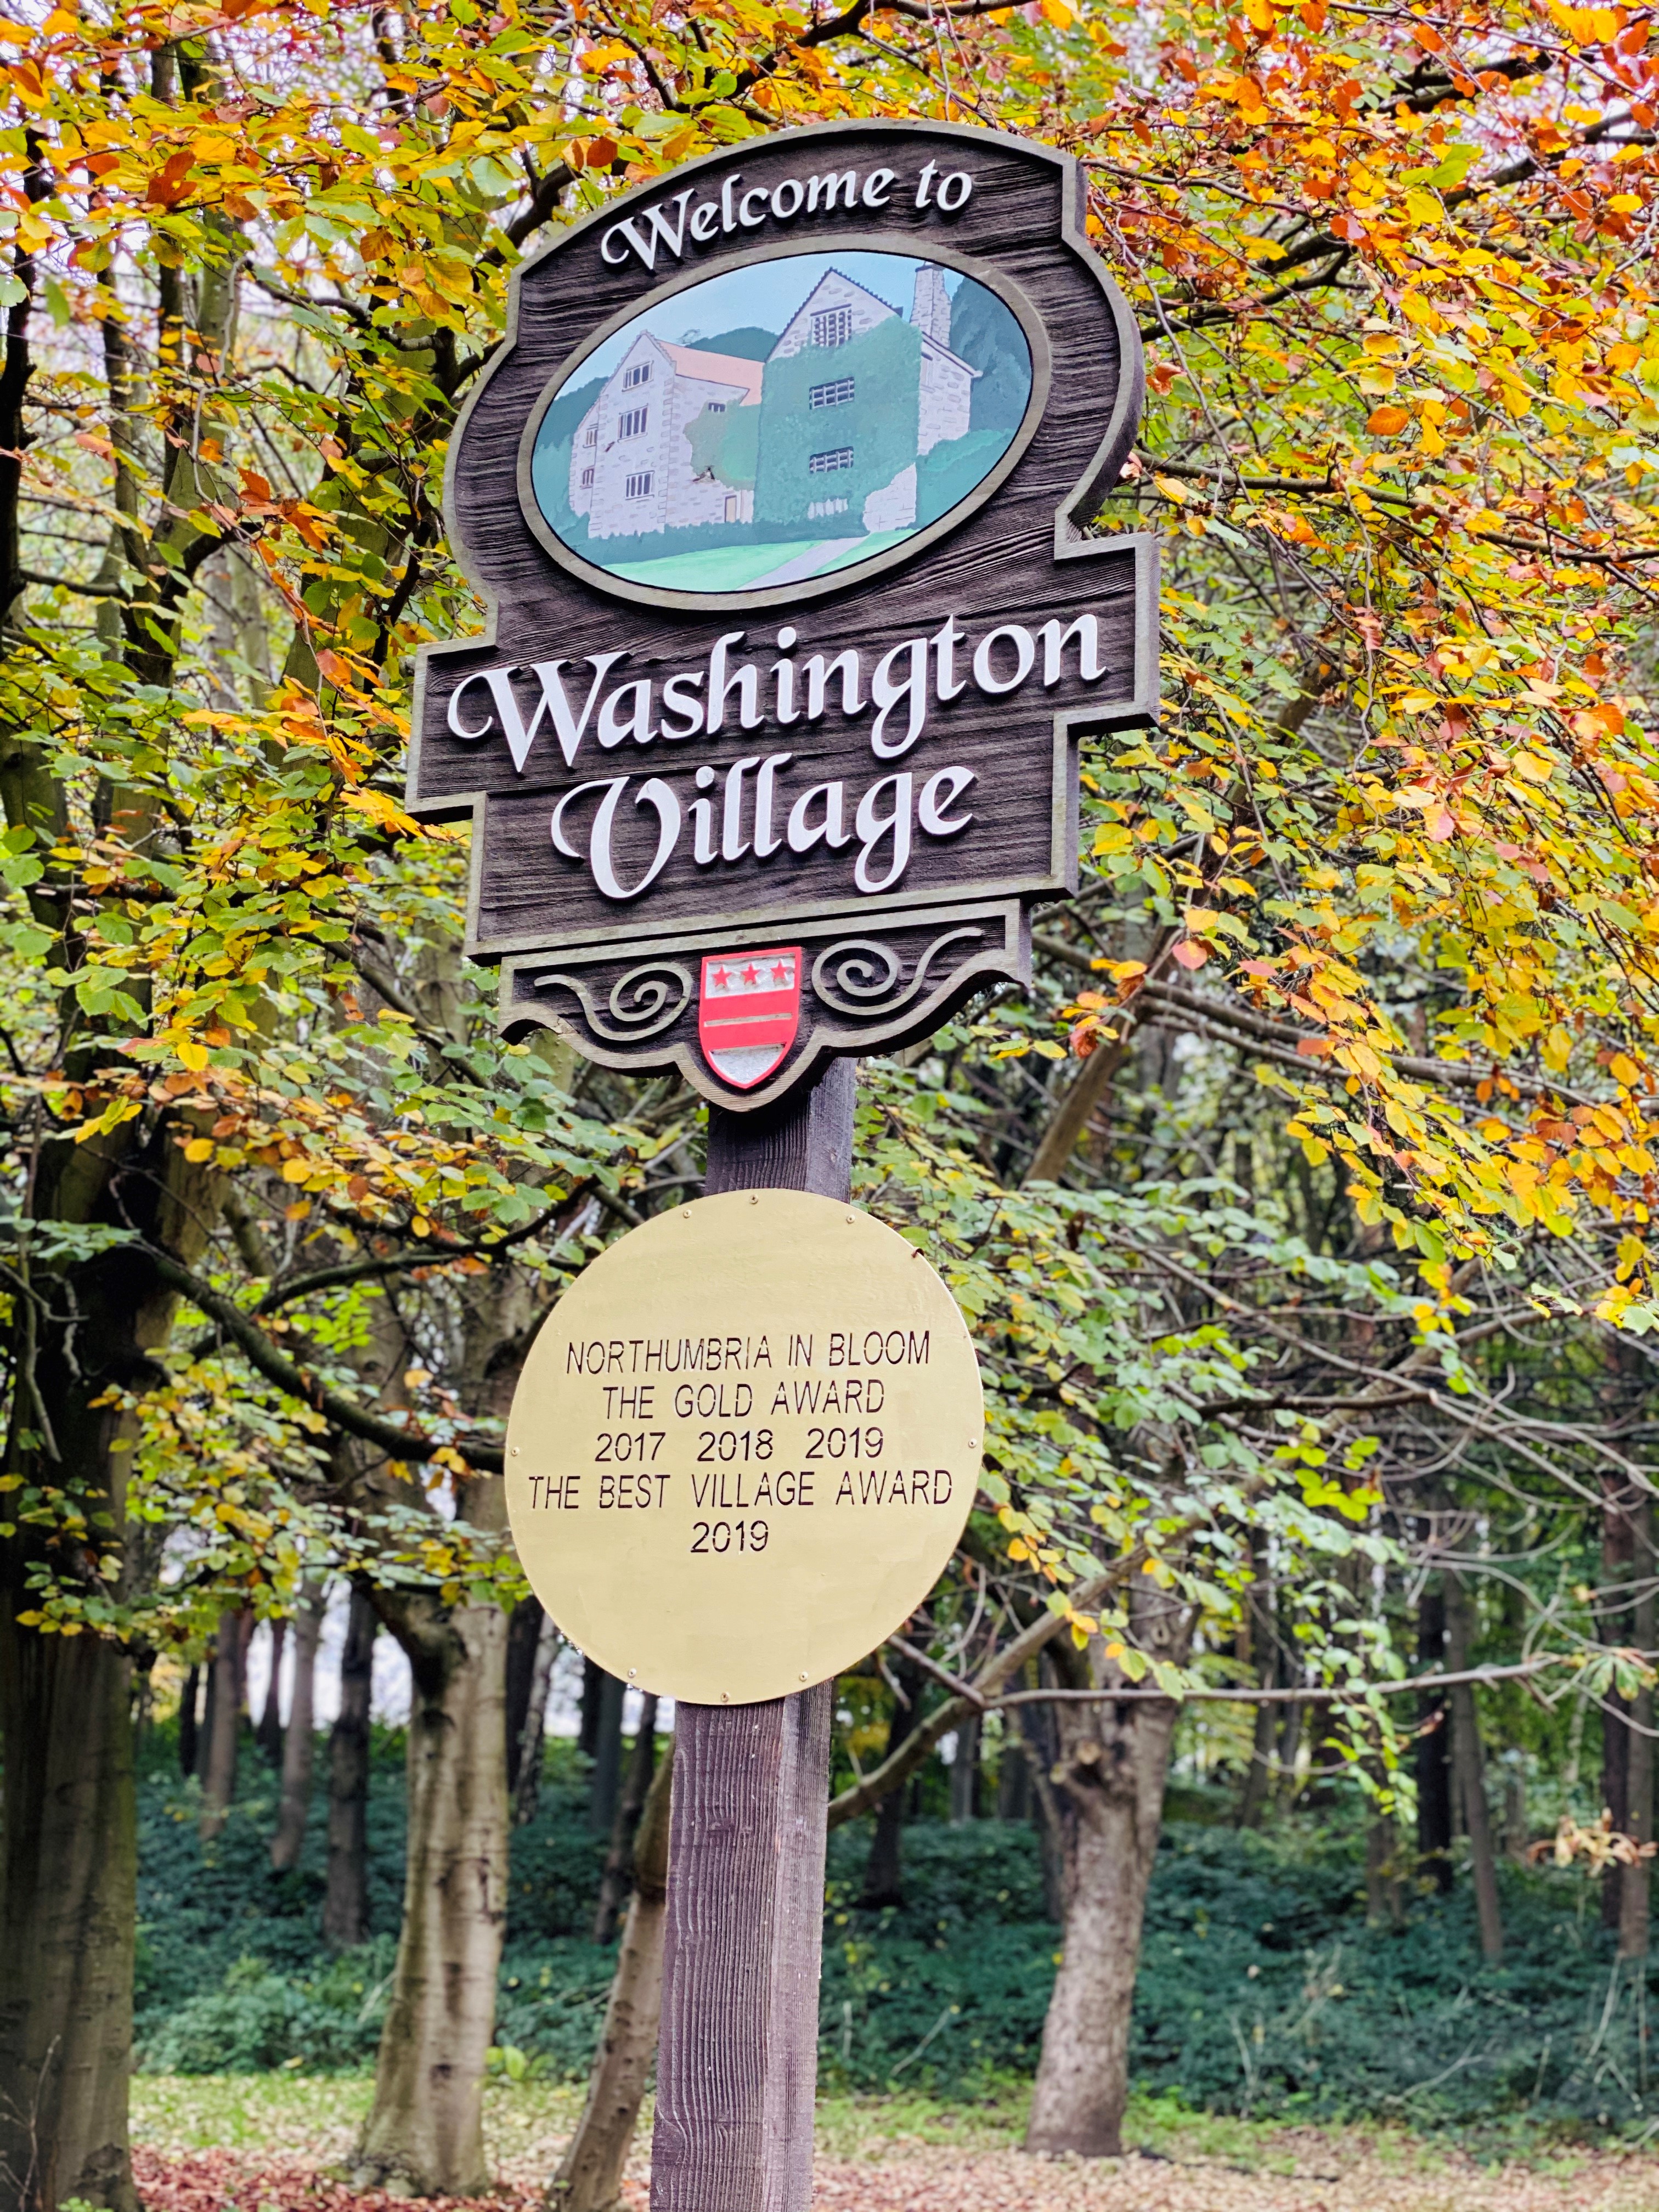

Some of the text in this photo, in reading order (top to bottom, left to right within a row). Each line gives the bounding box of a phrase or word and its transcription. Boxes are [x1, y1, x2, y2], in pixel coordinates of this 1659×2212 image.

[600, 159, 972, 272] Welcome to
[447, 613, 1107, 772] Washington
[551, 752, 977, 899] Village
[567, 1330, 929, 1375] NORTHUMBRIA IN BLOOM
[602, 1379, 884, 1419] THE GOLD AWARD
[595, 1427, 883, 1462] 2017 2018 2019
[529, 1470, 952, 1509] THE BEST VILLAGE AWARD
[690, 1520, 769, 1553] 2019
